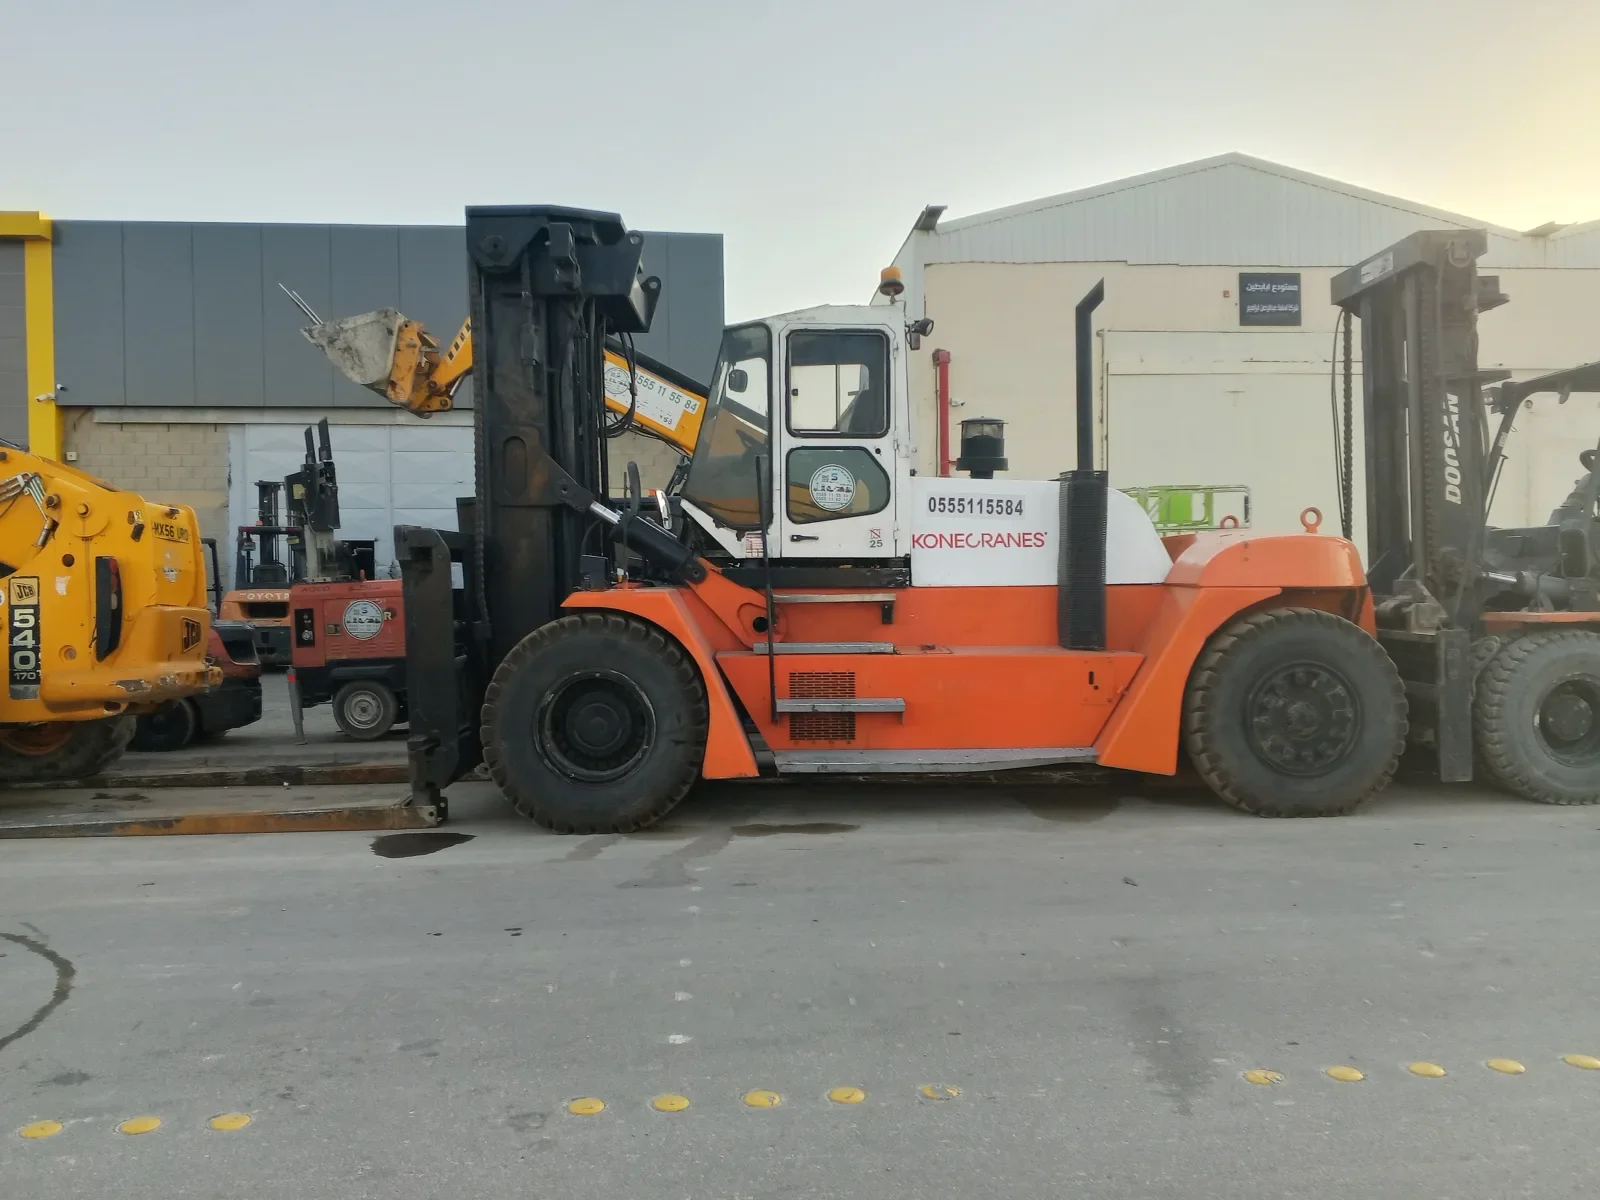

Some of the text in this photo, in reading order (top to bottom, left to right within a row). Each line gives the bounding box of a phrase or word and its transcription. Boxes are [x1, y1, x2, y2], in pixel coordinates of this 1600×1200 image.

[657, 385, 667, 397] 11
[668, 391, 683, 404] 55
[684, 399, 698, 412] 84
[1443, 392, 1461, 504] DOOSAN
[928, 496, 1024, 516] 0555115584
[153, 522, 175, 538] MX56
[869, 539, 883, 548] 25
[911, 532, 1046, 549] KONECRANES
[16, 584, 35, 600] JCB
[13, 672, 37, 680] 170
